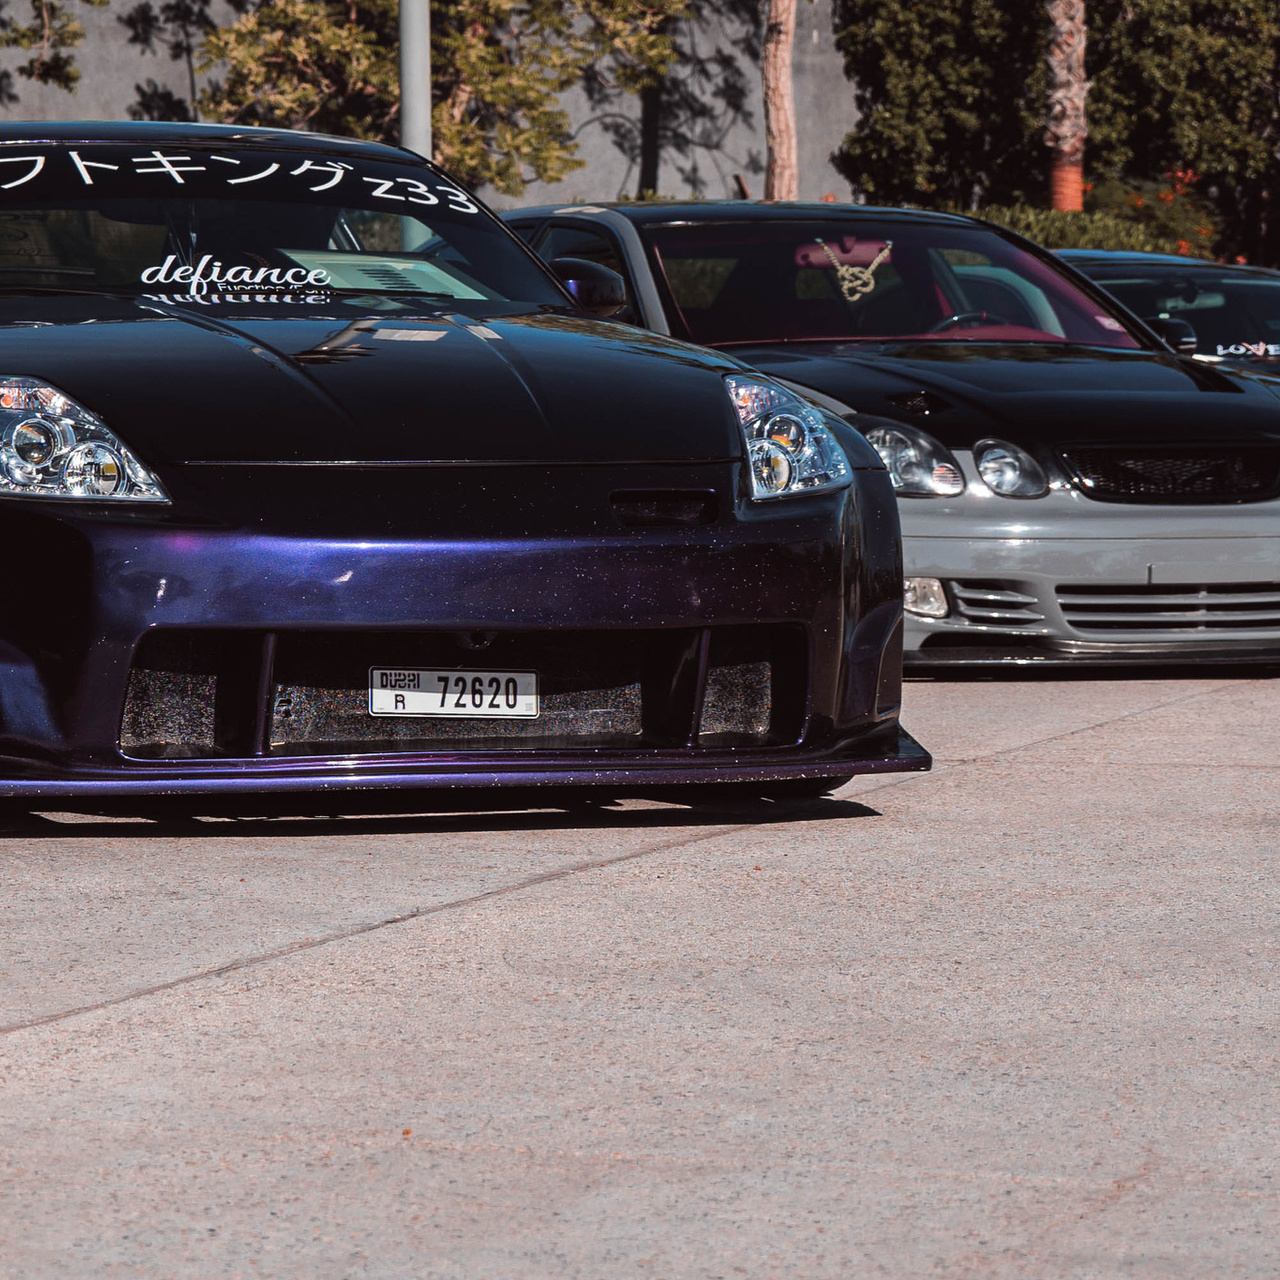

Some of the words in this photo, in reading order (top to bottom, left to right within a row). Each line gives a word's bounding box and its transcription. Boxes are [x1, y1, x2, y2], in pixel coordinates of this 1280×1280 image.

[140, 254, 332, 296] defiance
[380, 671, 421, 689] DUBAI
[437, 675, 518, 709] 72620
[394, 693, 406, 710] R
